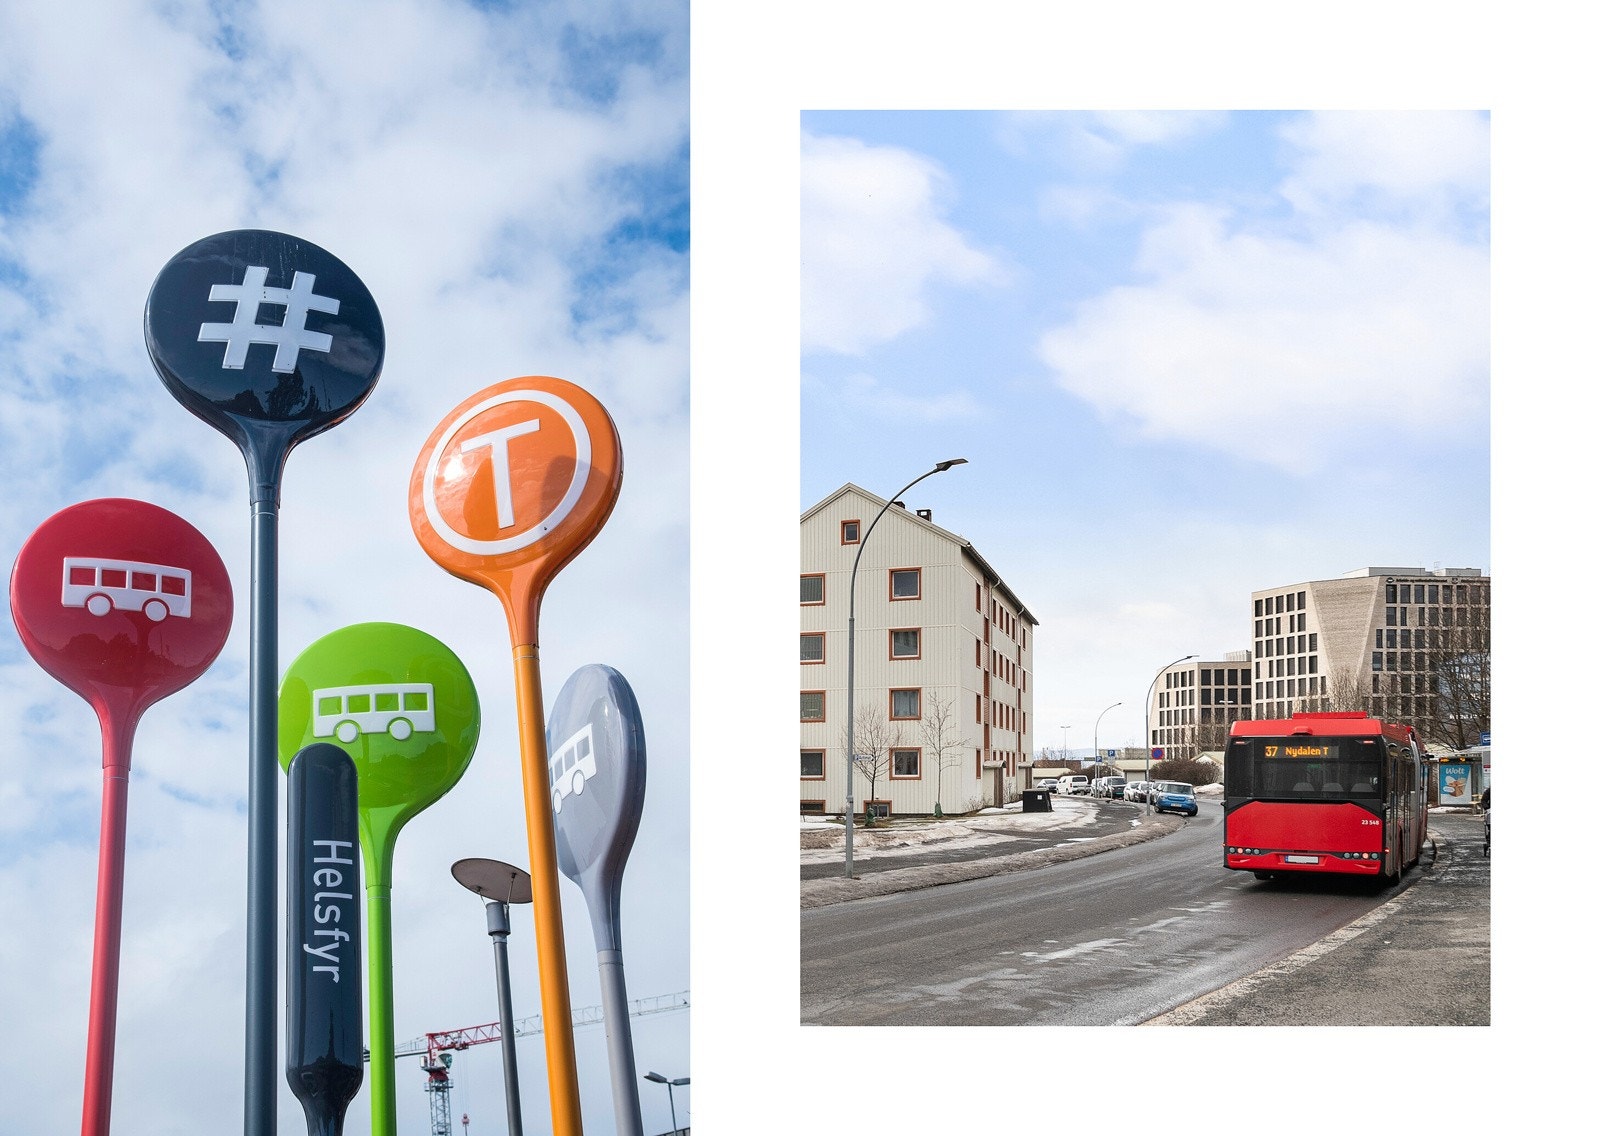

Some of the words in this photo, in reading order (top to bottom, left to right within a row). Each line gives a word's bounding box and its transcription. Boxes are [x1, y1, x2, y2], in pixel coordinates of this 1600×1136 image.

[461, 418, 541, 530] T
[1265, 746, 1278, 757] 37
[1285, 746, 1320, 757] Nydalen
[1323, 747, 1329, 756] T
[303, 840, 353, 984] Helsfyr
